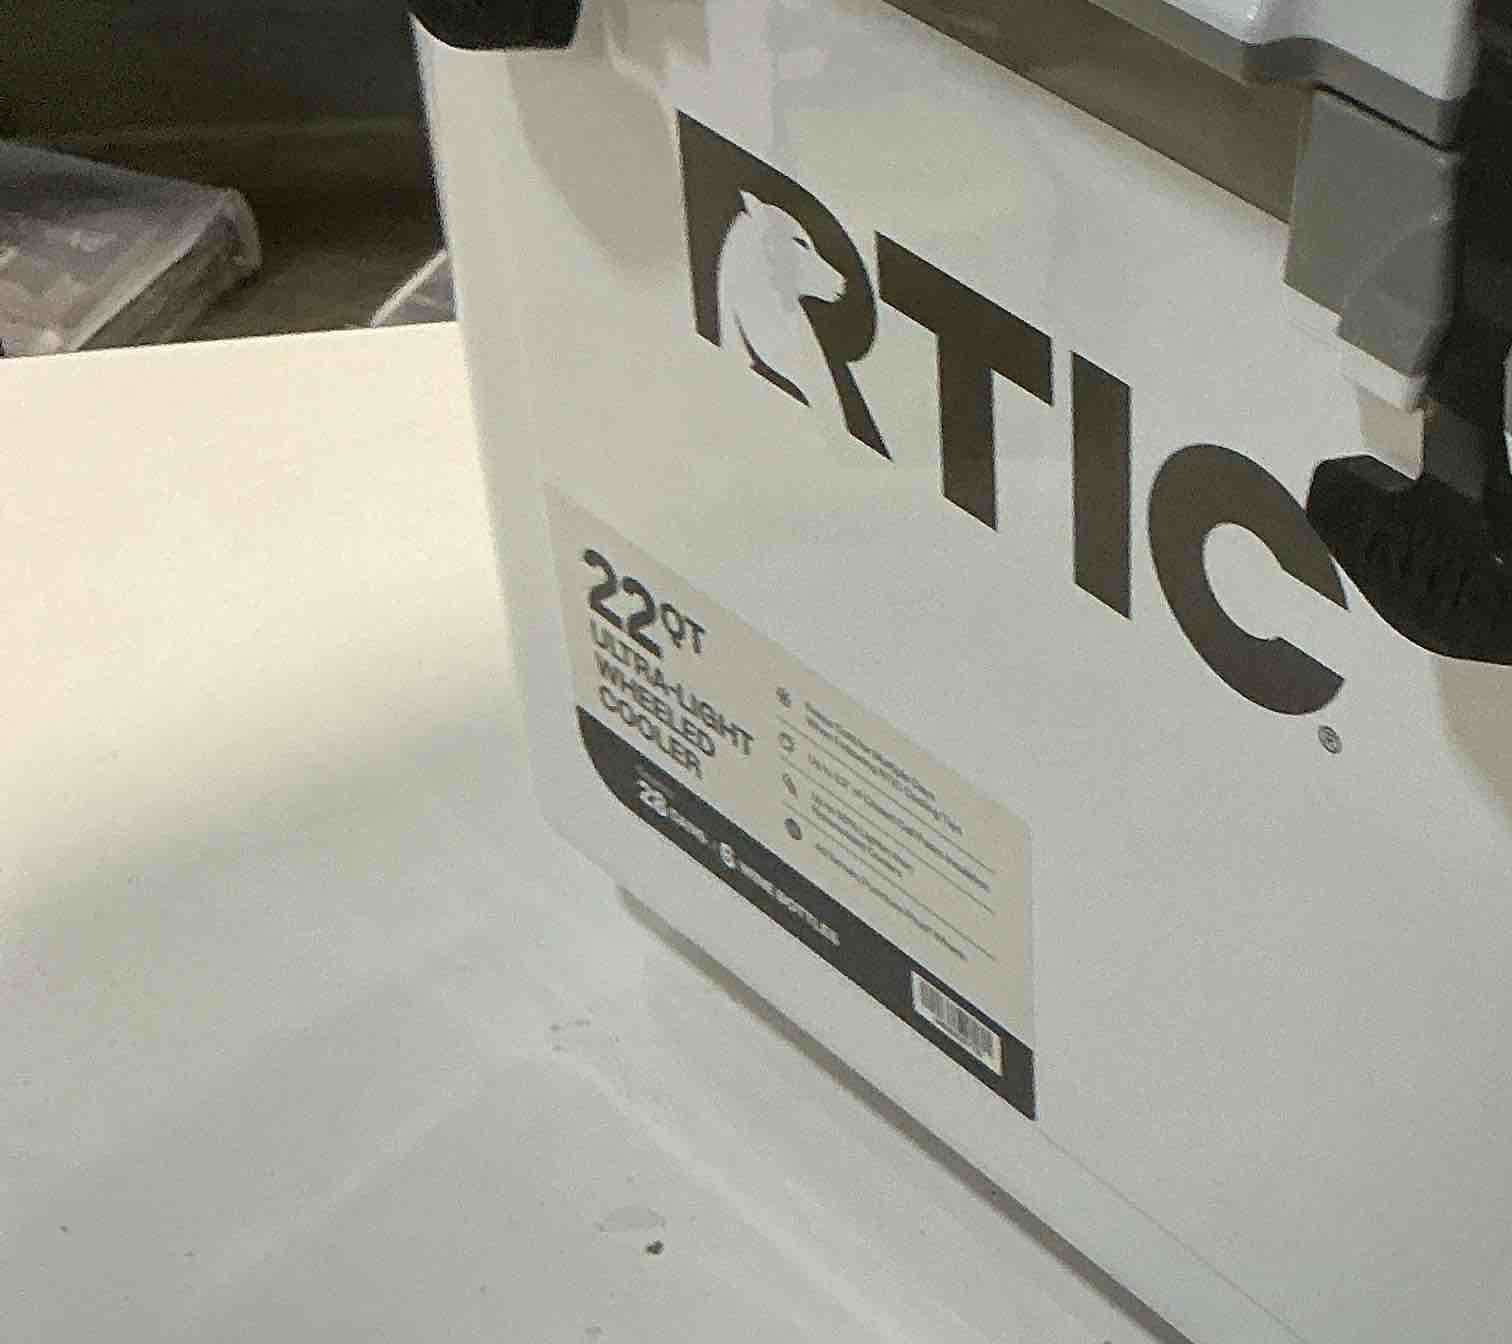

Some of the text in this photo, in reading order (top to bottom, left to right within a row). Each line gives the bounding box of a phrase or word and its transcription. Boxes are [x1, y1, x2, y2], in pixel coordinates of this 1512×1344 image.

[677, 110, 1349, 716] RTIC
[585, 549, 705, 658] 22 QT
[591, 619, 754, 756] ULTRA-LIGHT
[595, 652, 716, 757] WHEELED
[600, 686, 703, 781] COOLER
